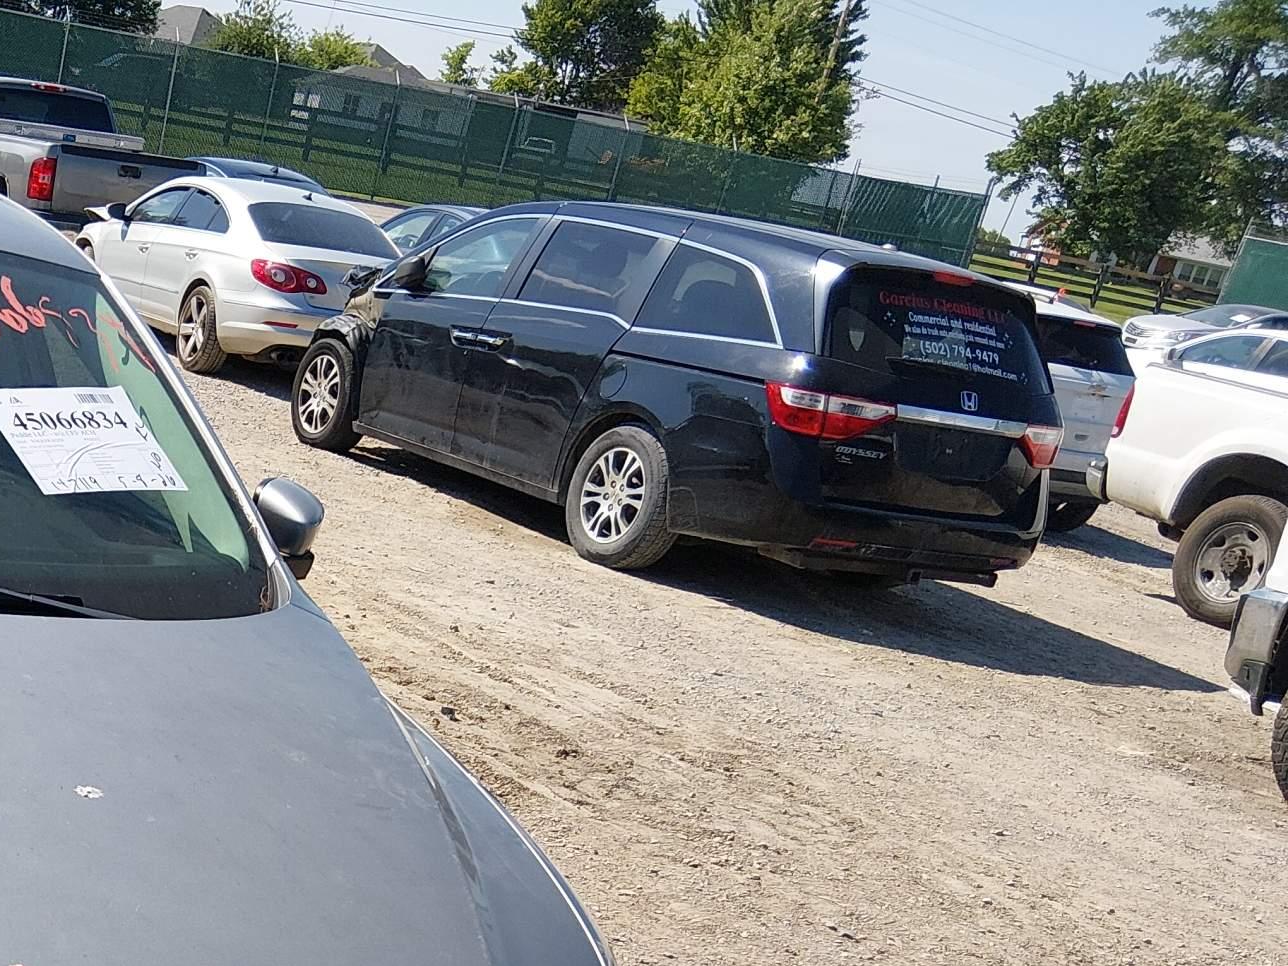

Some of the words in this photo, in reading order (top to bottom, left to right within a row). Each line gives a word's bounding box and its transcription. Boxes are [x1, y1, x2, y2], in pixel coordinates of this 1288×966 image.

[933, 299, 985, 318] Cleaning
[908, 311, 949, 327] Commercial
[950, 318, 963, 329] and
[964, 321, 997, 336] residential
[919, 340, 951, 358] (502)
[952, 344, 1000, 365] 794-9479
[13, 410, 128, 431] 45066834
[835, 445, 888, 460] ODYSSEY
